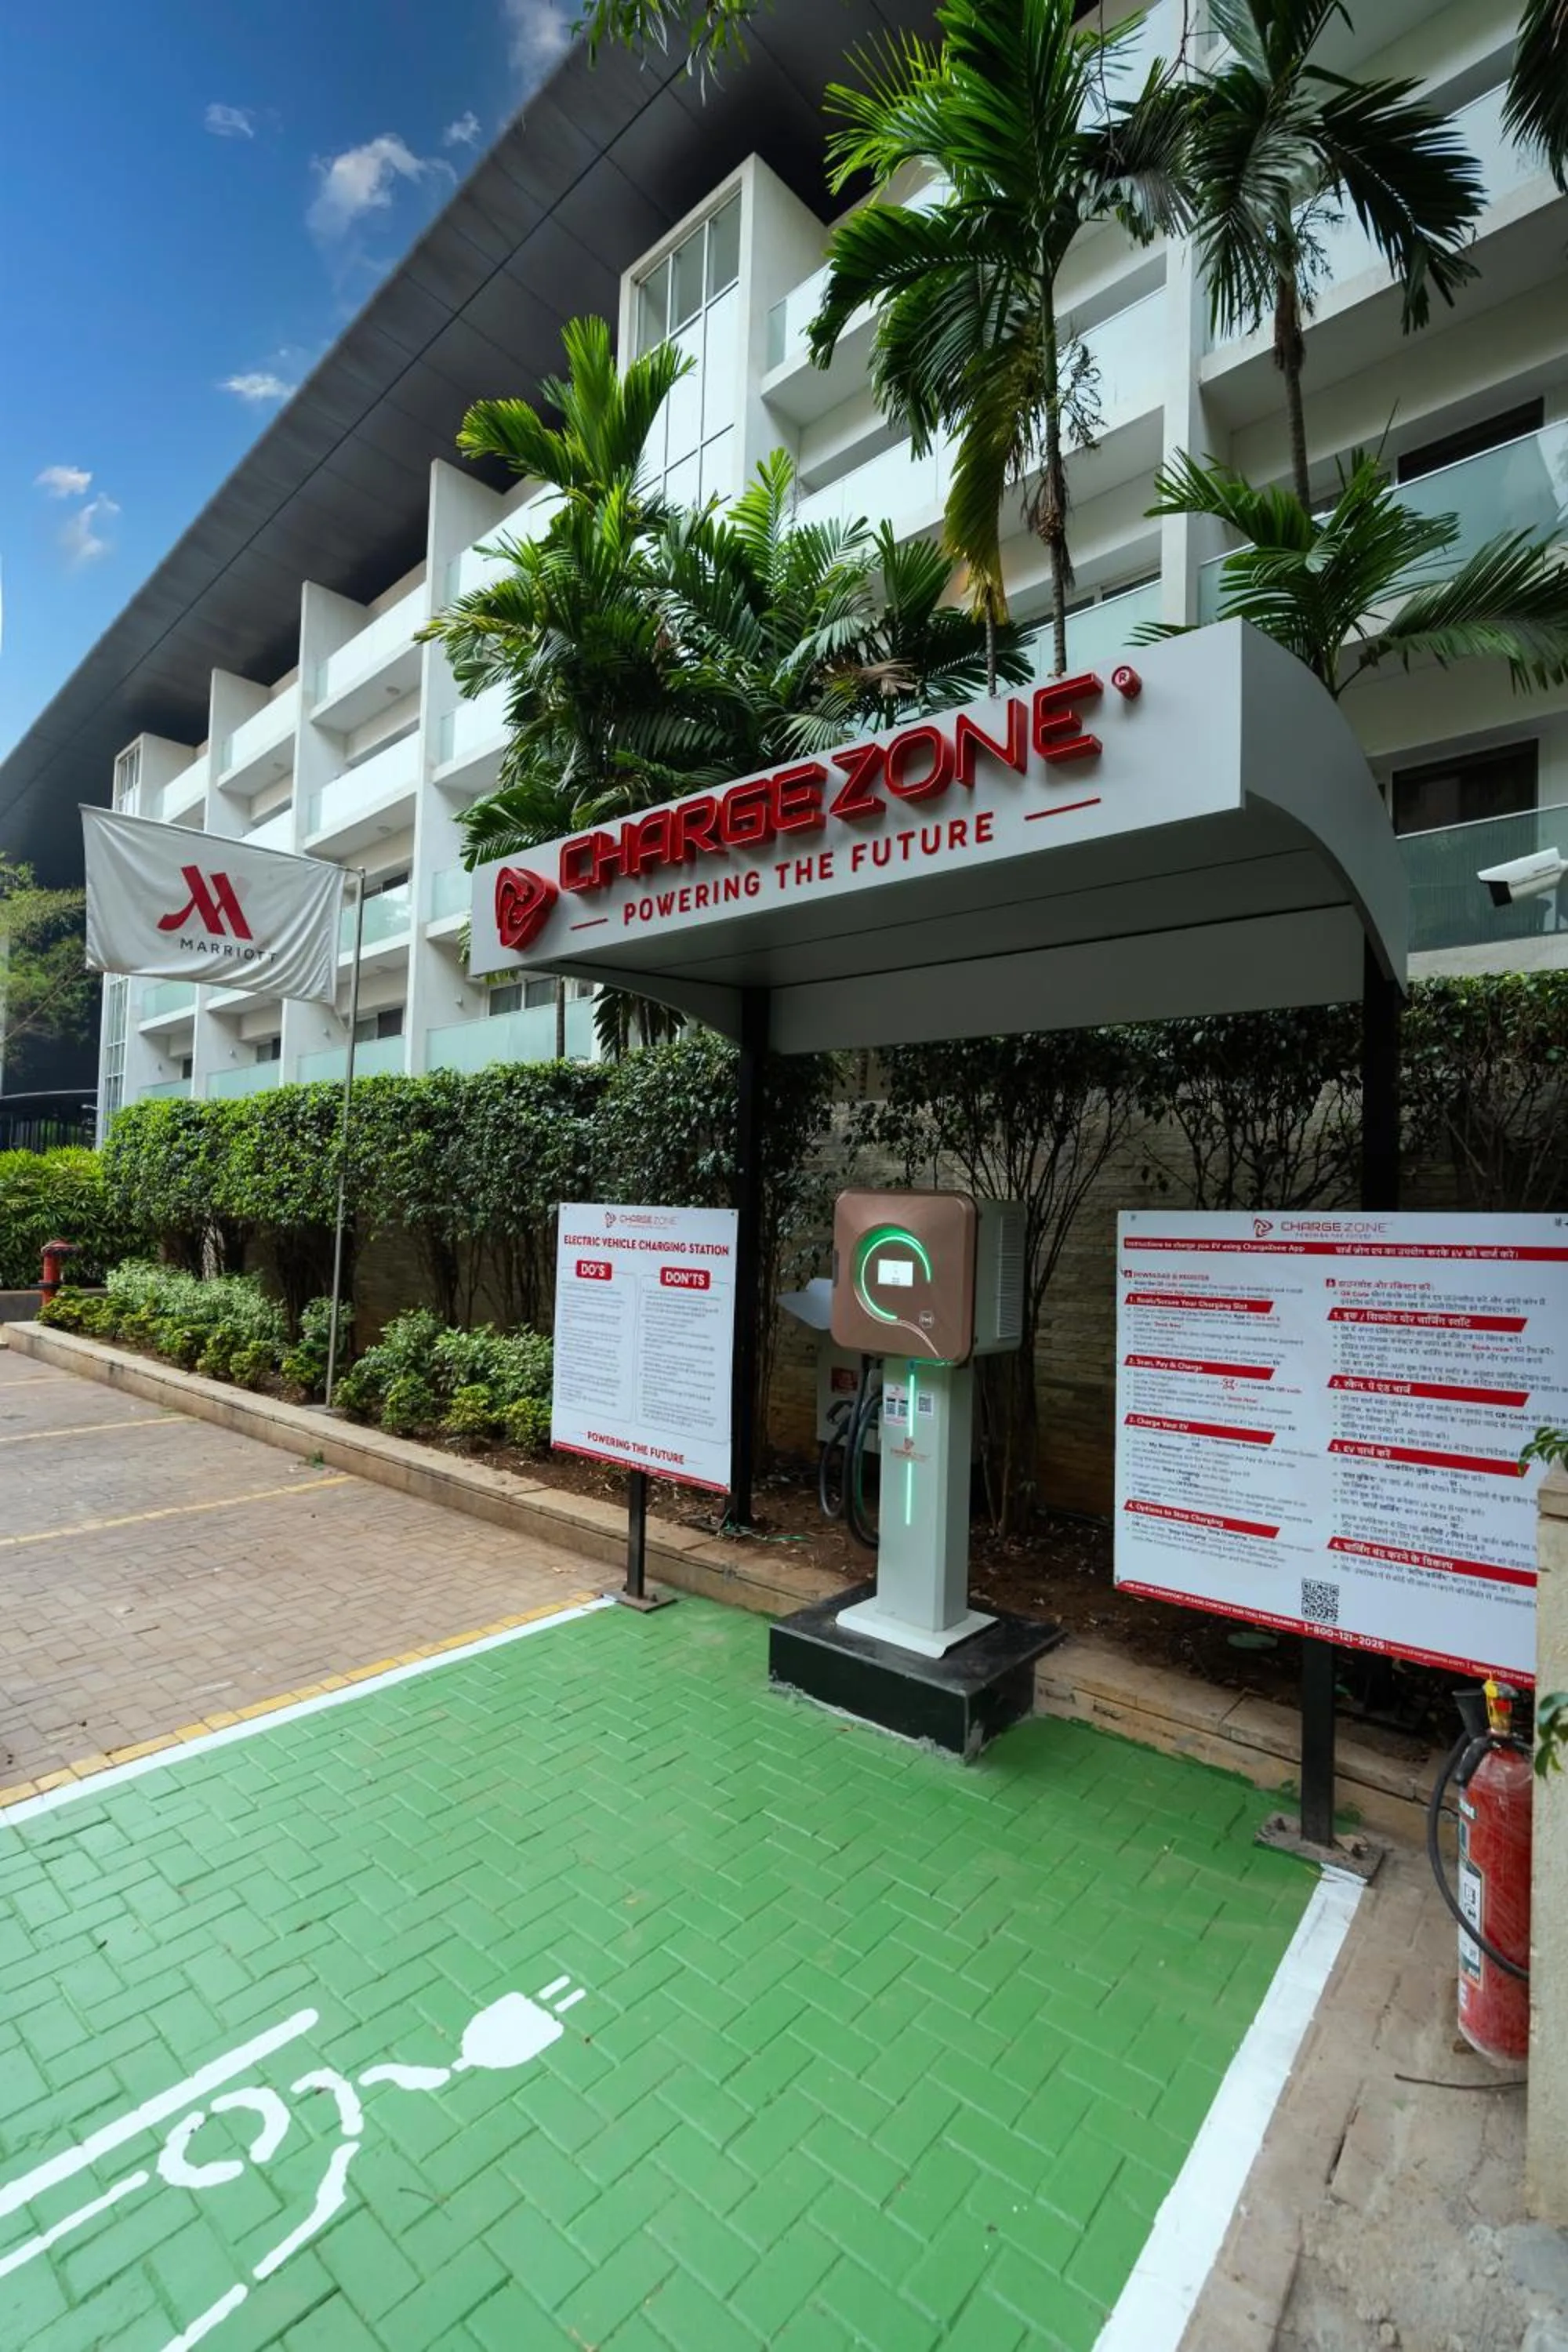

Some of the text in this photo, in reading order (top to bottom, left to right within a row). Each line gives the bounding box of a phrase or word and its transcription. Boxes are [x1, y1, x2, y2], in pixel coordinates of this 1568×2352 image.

[623, 811, 994, 927] POWERING THE FUTURE
[180, 938, 277, 964] MARRIOTT
[564, 1235, 728, 1255] ELECTRIC VEHICLE CHARGING STATION
[588, 1431, 684, 1465] POWERING THE FUTURE
